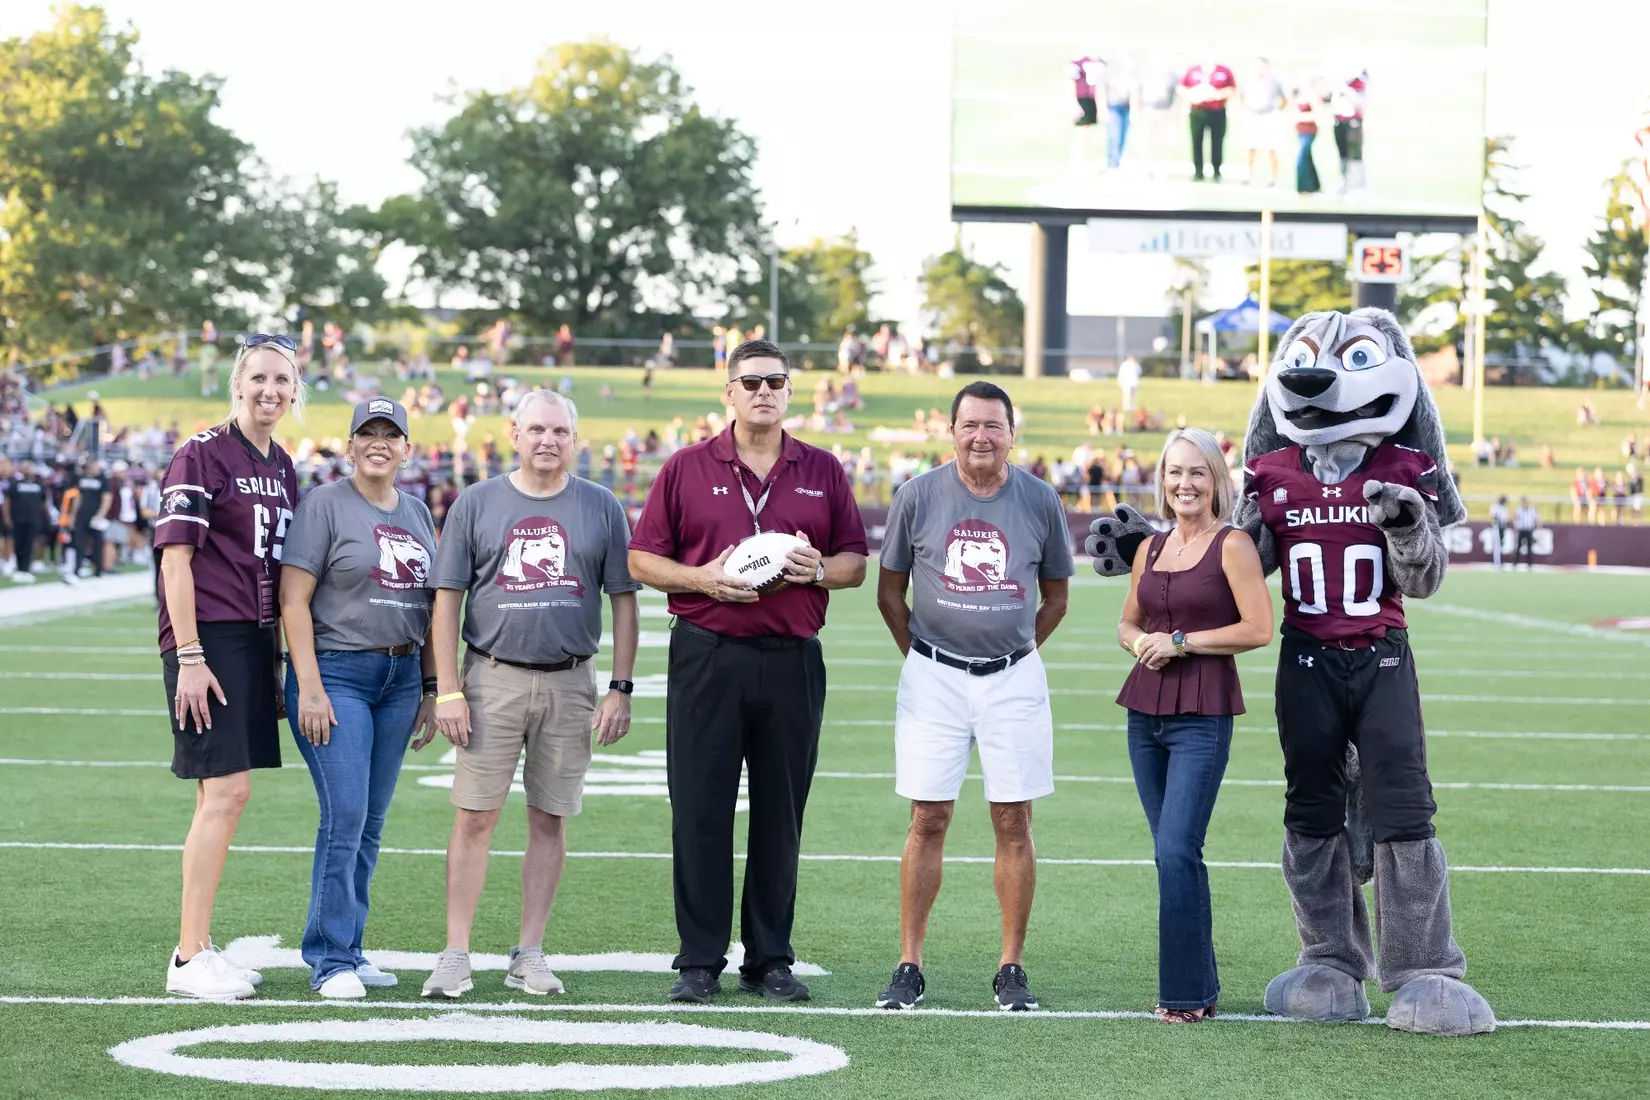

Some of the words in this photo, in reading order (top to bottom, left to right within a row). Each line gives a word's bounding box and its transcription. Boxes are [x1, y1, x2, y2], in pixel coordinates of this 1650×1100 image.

[1362, 247, 1402, 275] 25
[1285, 506, 1371, 527] SALUKI
[376, 528, 414, 541] SALUKIS
[512, 525, 559, 536] SALUKIS
[953, 528, 999, 538] SALUKIS
[738, 555, 771, 574] Wilson
[1289, 542, 1383, 616] 00
[514, 583, 535, 591] YEARS
[1379, 657, 1400, 668] SIU
